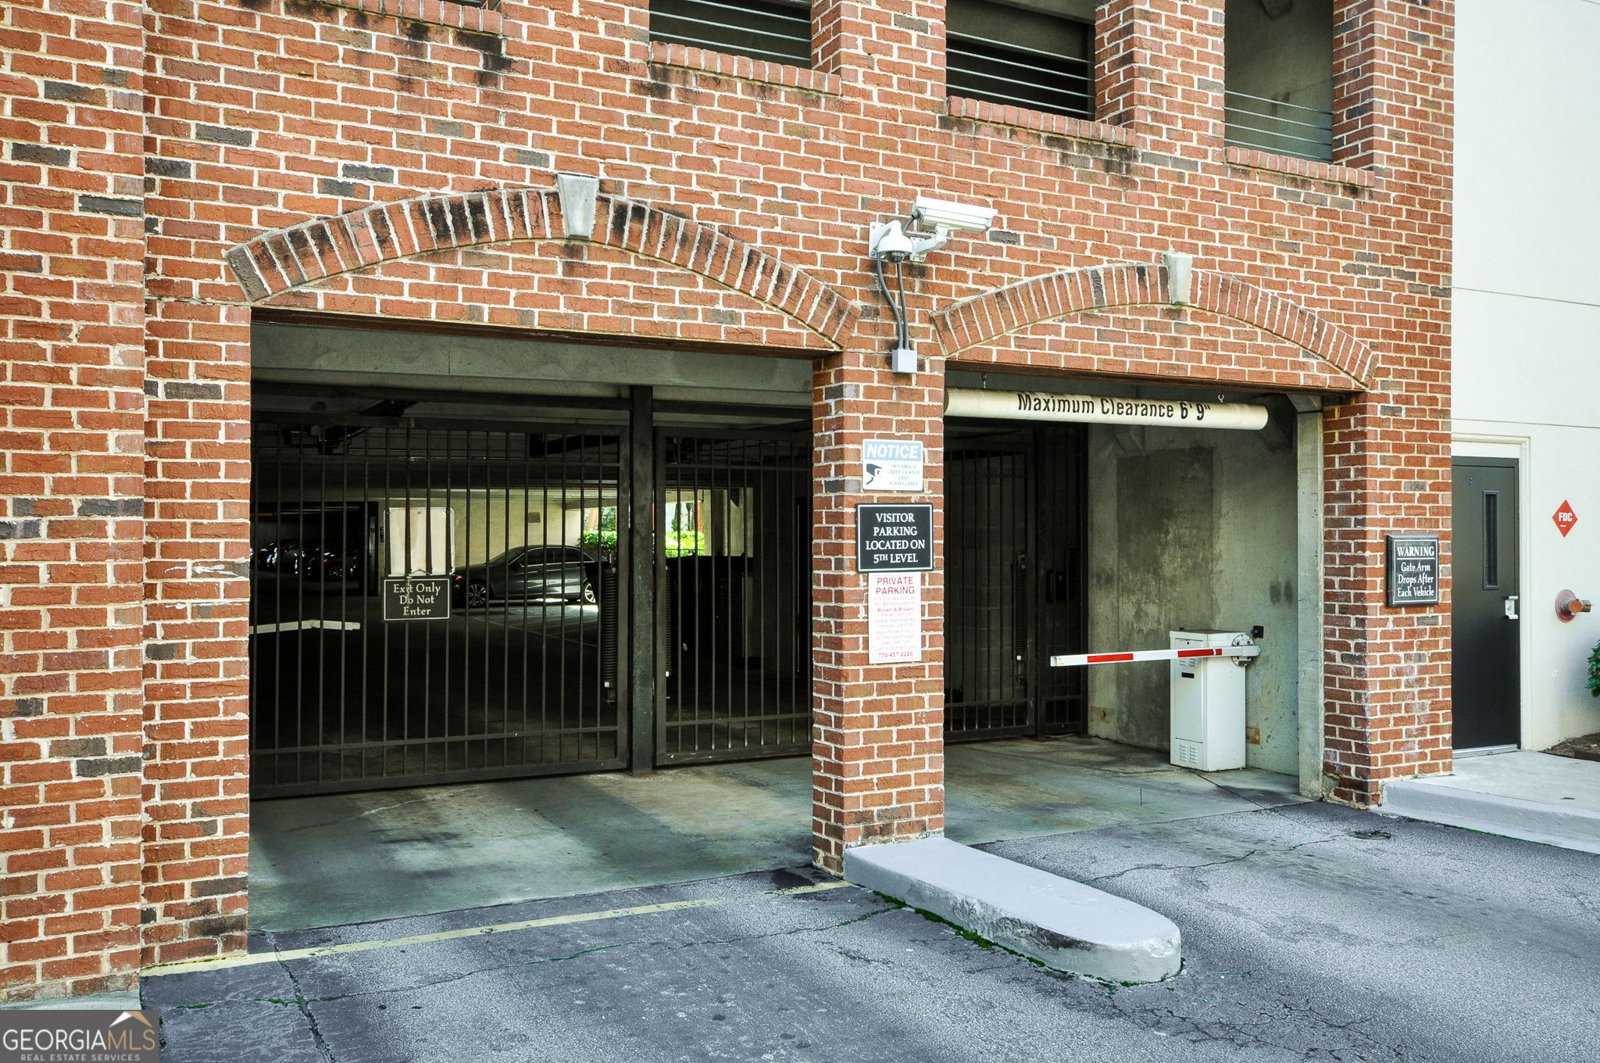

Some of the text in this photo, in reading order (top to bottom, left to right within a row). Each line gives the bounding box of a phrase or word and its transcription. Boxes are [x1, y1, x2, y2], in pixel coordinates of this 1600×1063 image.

[1018, 393, 1095, 414] Maximum
[1101, 398, 1174, 418] Clearance
[866, 443, 920, 459] NOTICE
[876, 512, 915, 522] VISITOR
[1558, 512, 1573, 522] FDC
[873, 526, 918, 536] PARKING
[866, 540, 926, 550] LOCATED ON
[1396, 546, 1435, 557] WARNING
[890, 553, 918, 564] LEVEL
[1400, 561, 1430, 572] Gate Arm
[877, 576, 914, 585] PRIVATE
[1398, 572, 1434, 588] Drops After
[416, 582, 440, 596] Only
[876, 586, 914, 595] PARKING
[1398, 586, 1434, 597] Each Vehicle
[400, 594, 435, 604] Do Not
[403, 606, 432, 616] Enter
